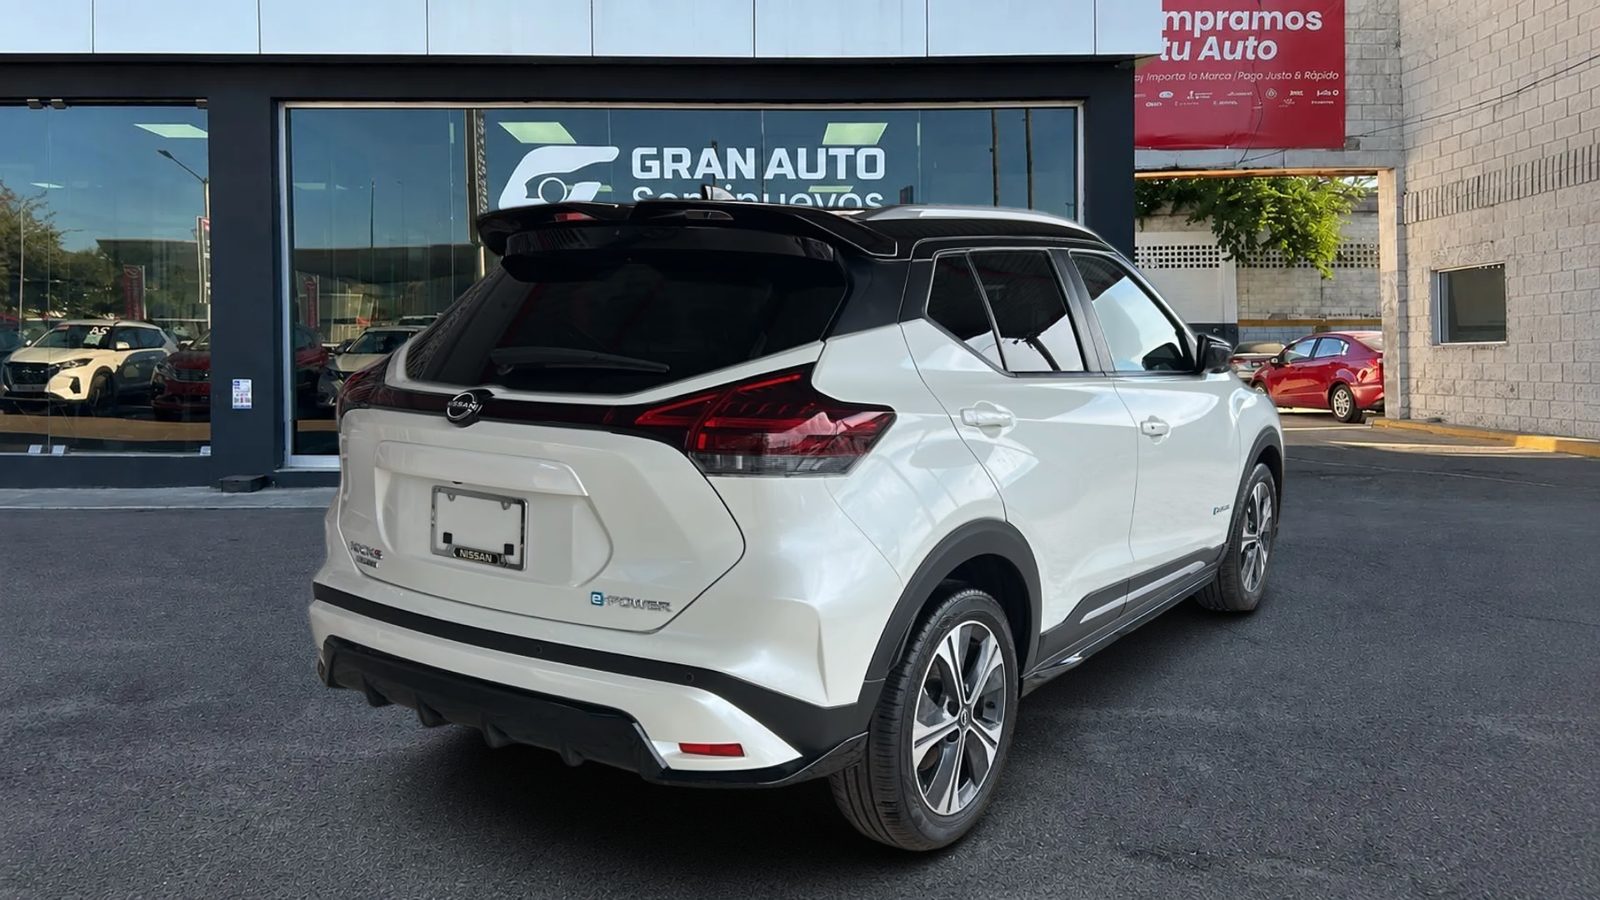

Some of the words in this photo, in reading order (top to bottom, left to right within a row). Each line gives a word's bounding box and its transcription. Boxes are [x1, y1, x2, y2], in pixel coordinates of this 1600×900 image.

[1160, 37, 1191, 61] tu
[1198, 36, 1277, 61] Auto
[1147, 73, 1185, 82] Importa
[1200, 72, 1231, 80] Marca
[1266, 72, 1292, 80] Justo
[632, 147, 755, 180] GRAN
[763, 147, 885, 180] AUTO
[632, 184, 884, 208] Suevos
[459, 549, 493, 562] NISSAN
